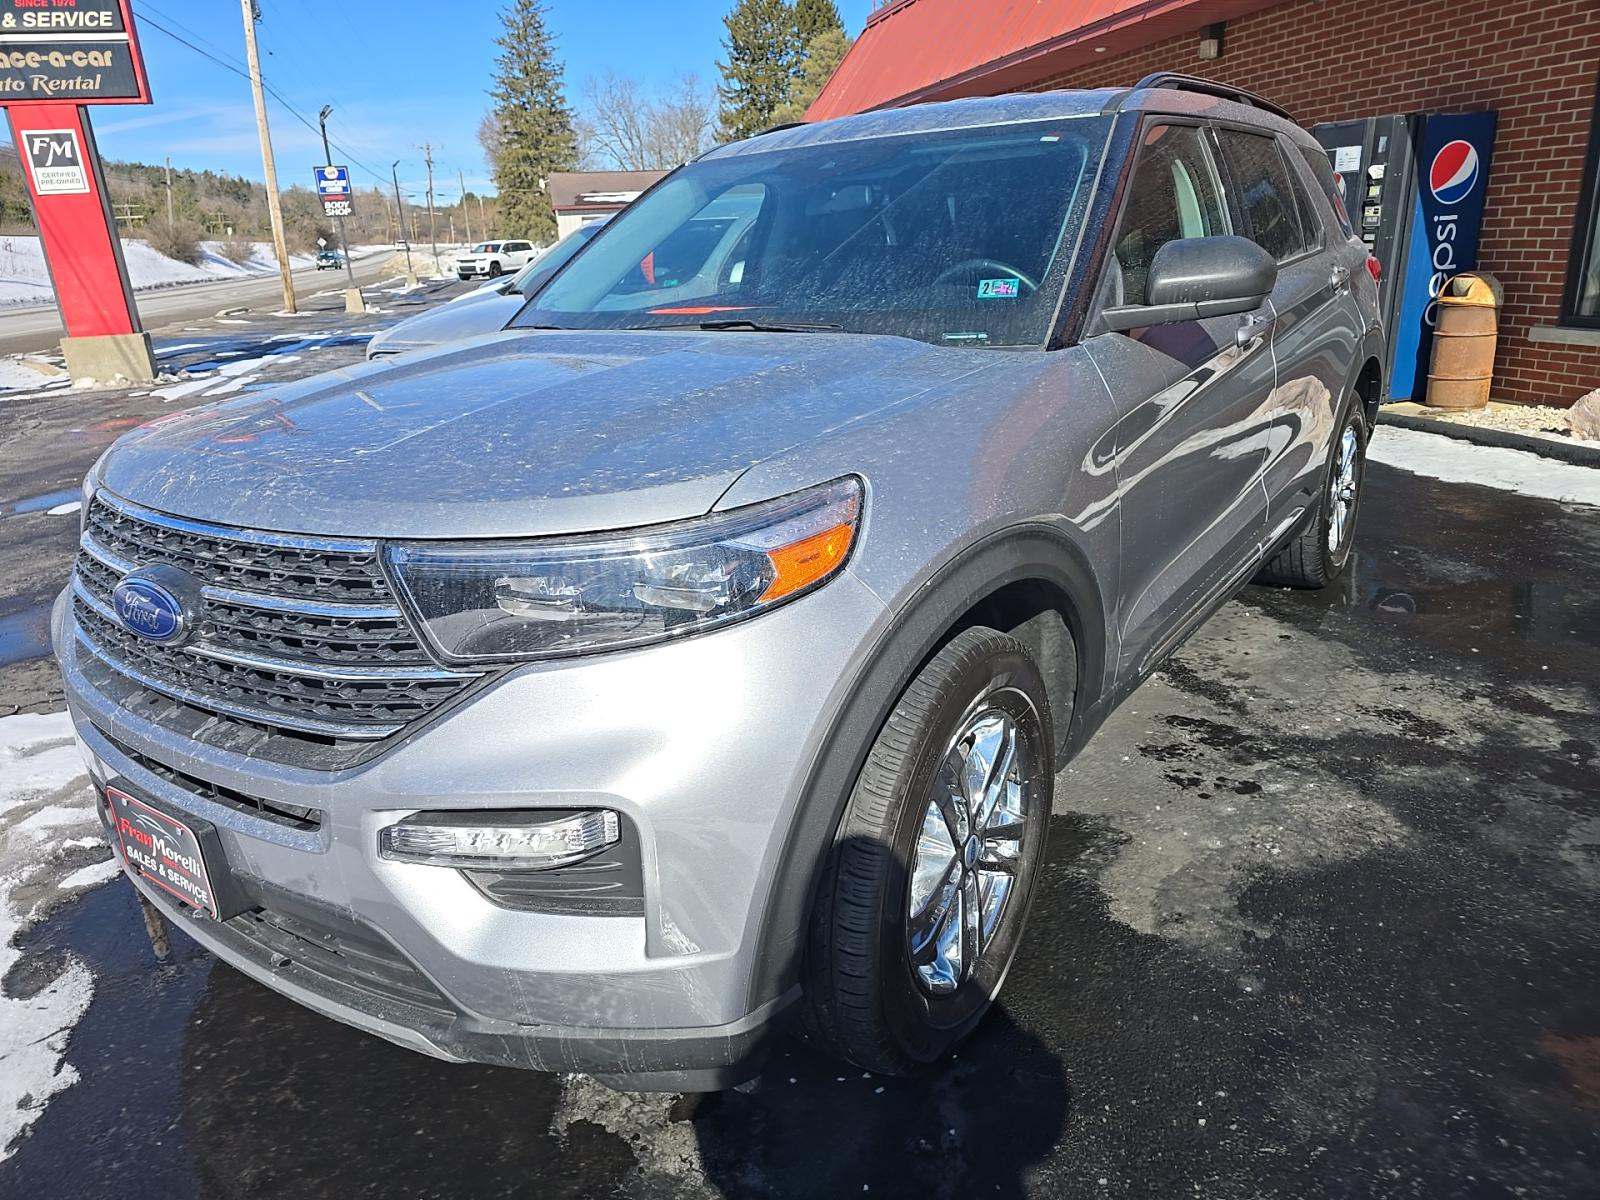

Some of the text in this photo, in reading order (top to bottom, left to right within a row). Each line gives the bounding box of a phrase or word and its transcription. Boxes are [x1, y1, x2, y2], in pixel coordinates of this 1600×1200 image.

[2, 11, 113, 28] & SERVICE
[29, 74, 101, 95] Rental
[325, 208, 352, 216] SHOP
[123, 590, 160, 630] Ford
[151, 833, 202, 879] Morelli
[126, 845, 157, 872] SALES
[159, 863, 167, 877] &
[167, 868, 209, 904] SERVICE
